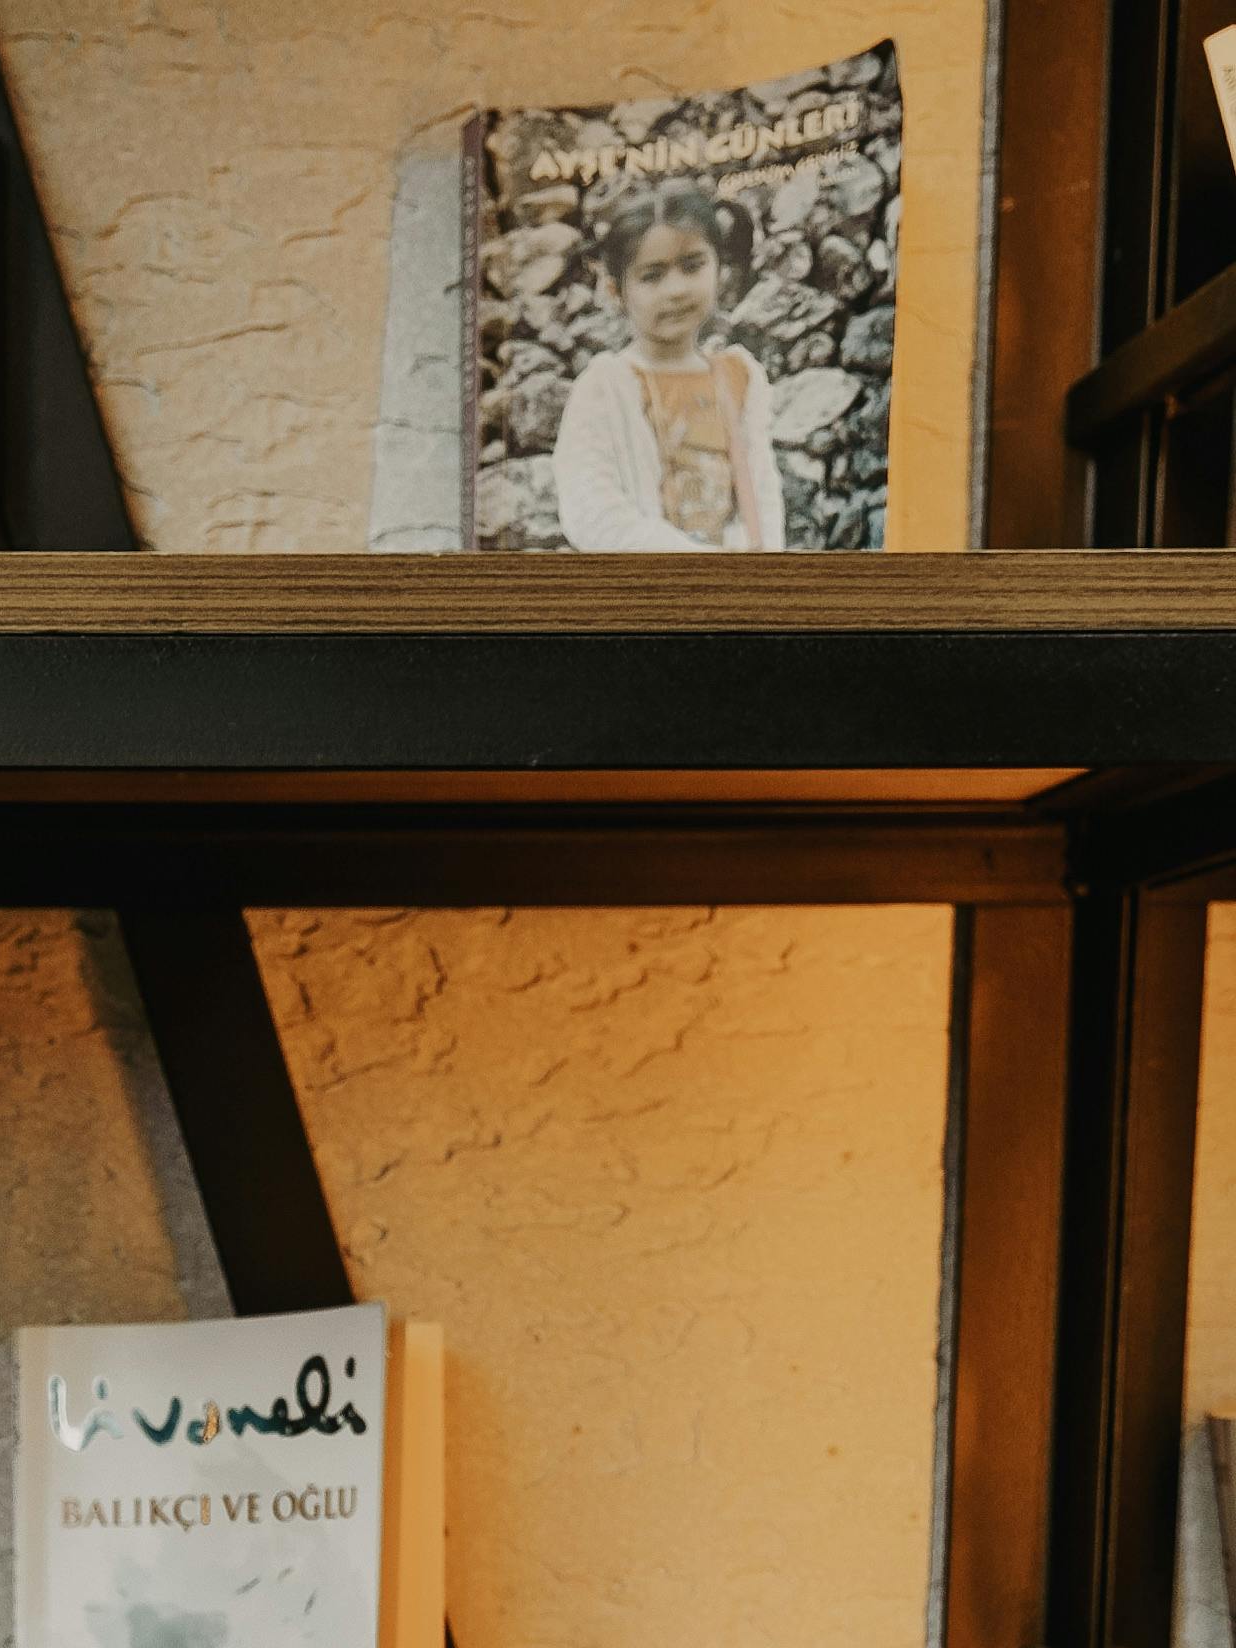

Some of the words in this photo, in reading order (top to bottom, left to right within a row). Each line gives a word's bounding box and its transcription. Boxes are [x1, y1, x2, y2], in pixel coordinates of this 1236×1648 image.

[60, 1493, 212, 1533] BALIKÇI
[222, 1492, 262, 1524] VE
[272, 1482, 359, 1522] OĞLU
